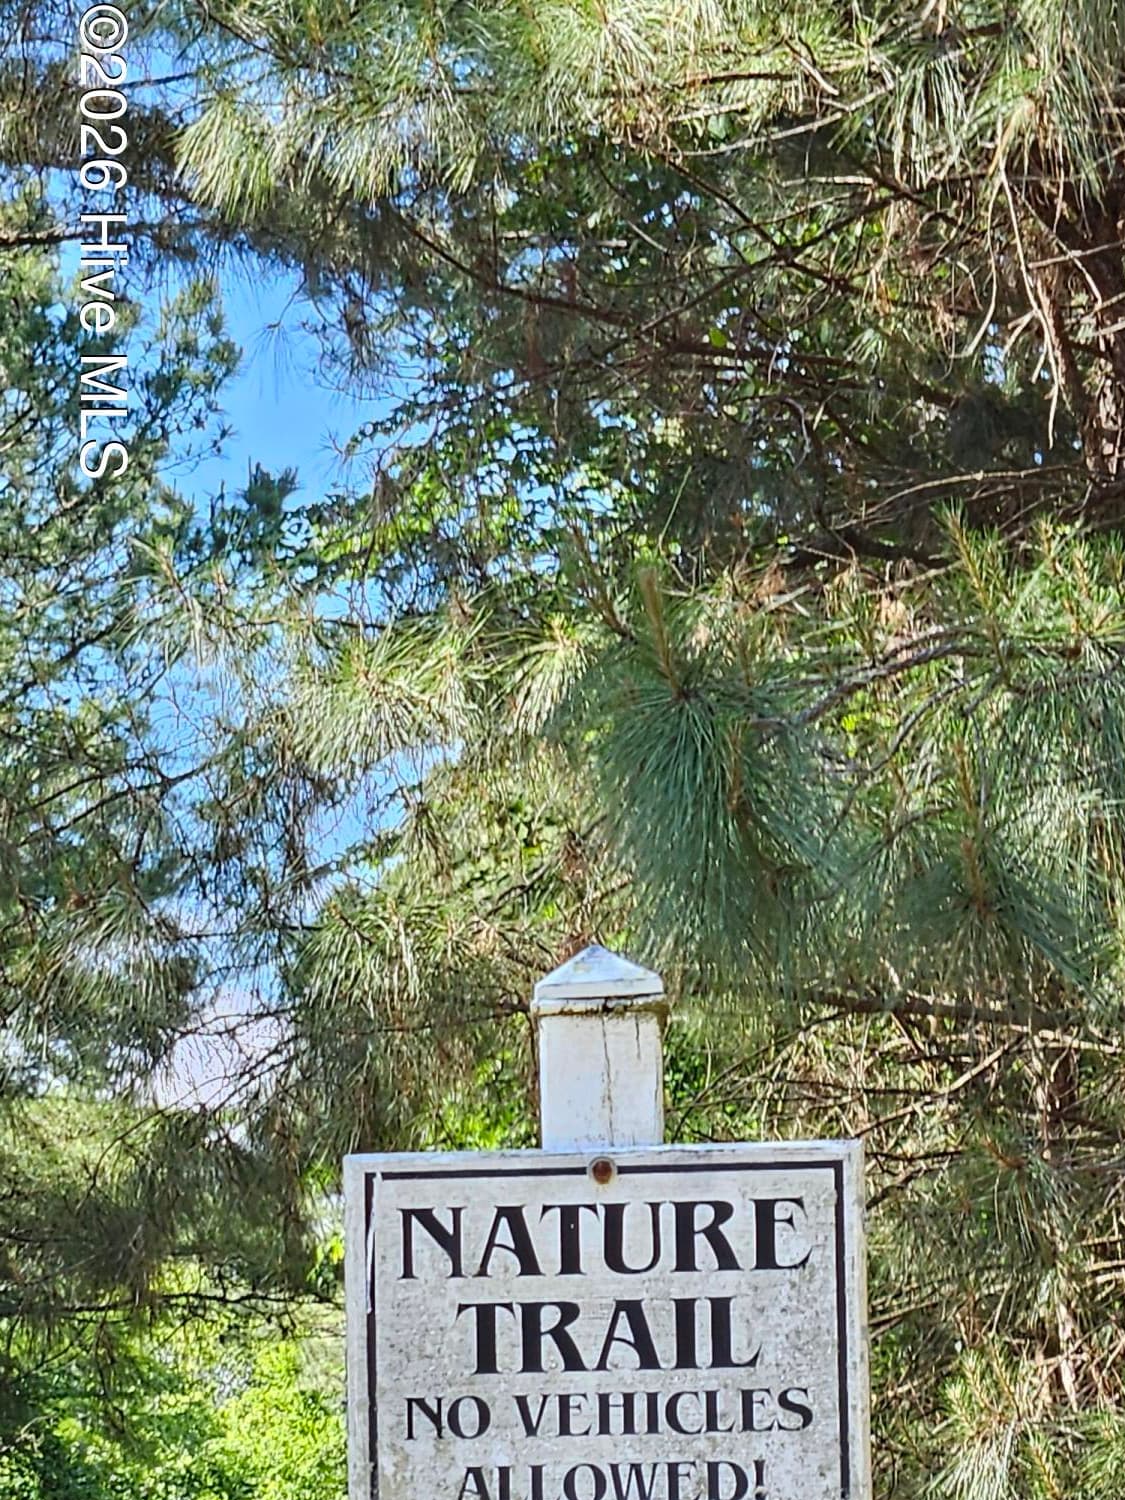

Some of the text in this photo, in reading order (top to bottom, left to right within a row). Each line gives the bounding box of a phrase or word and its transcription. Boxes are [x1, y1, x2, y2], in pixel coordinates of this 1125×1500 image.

[398, 1197, 813, 1280] NATURE
[457, 1296, 761, 1375] TRAIL
[405, 1387, 813, 1440] NO VEHICLES
